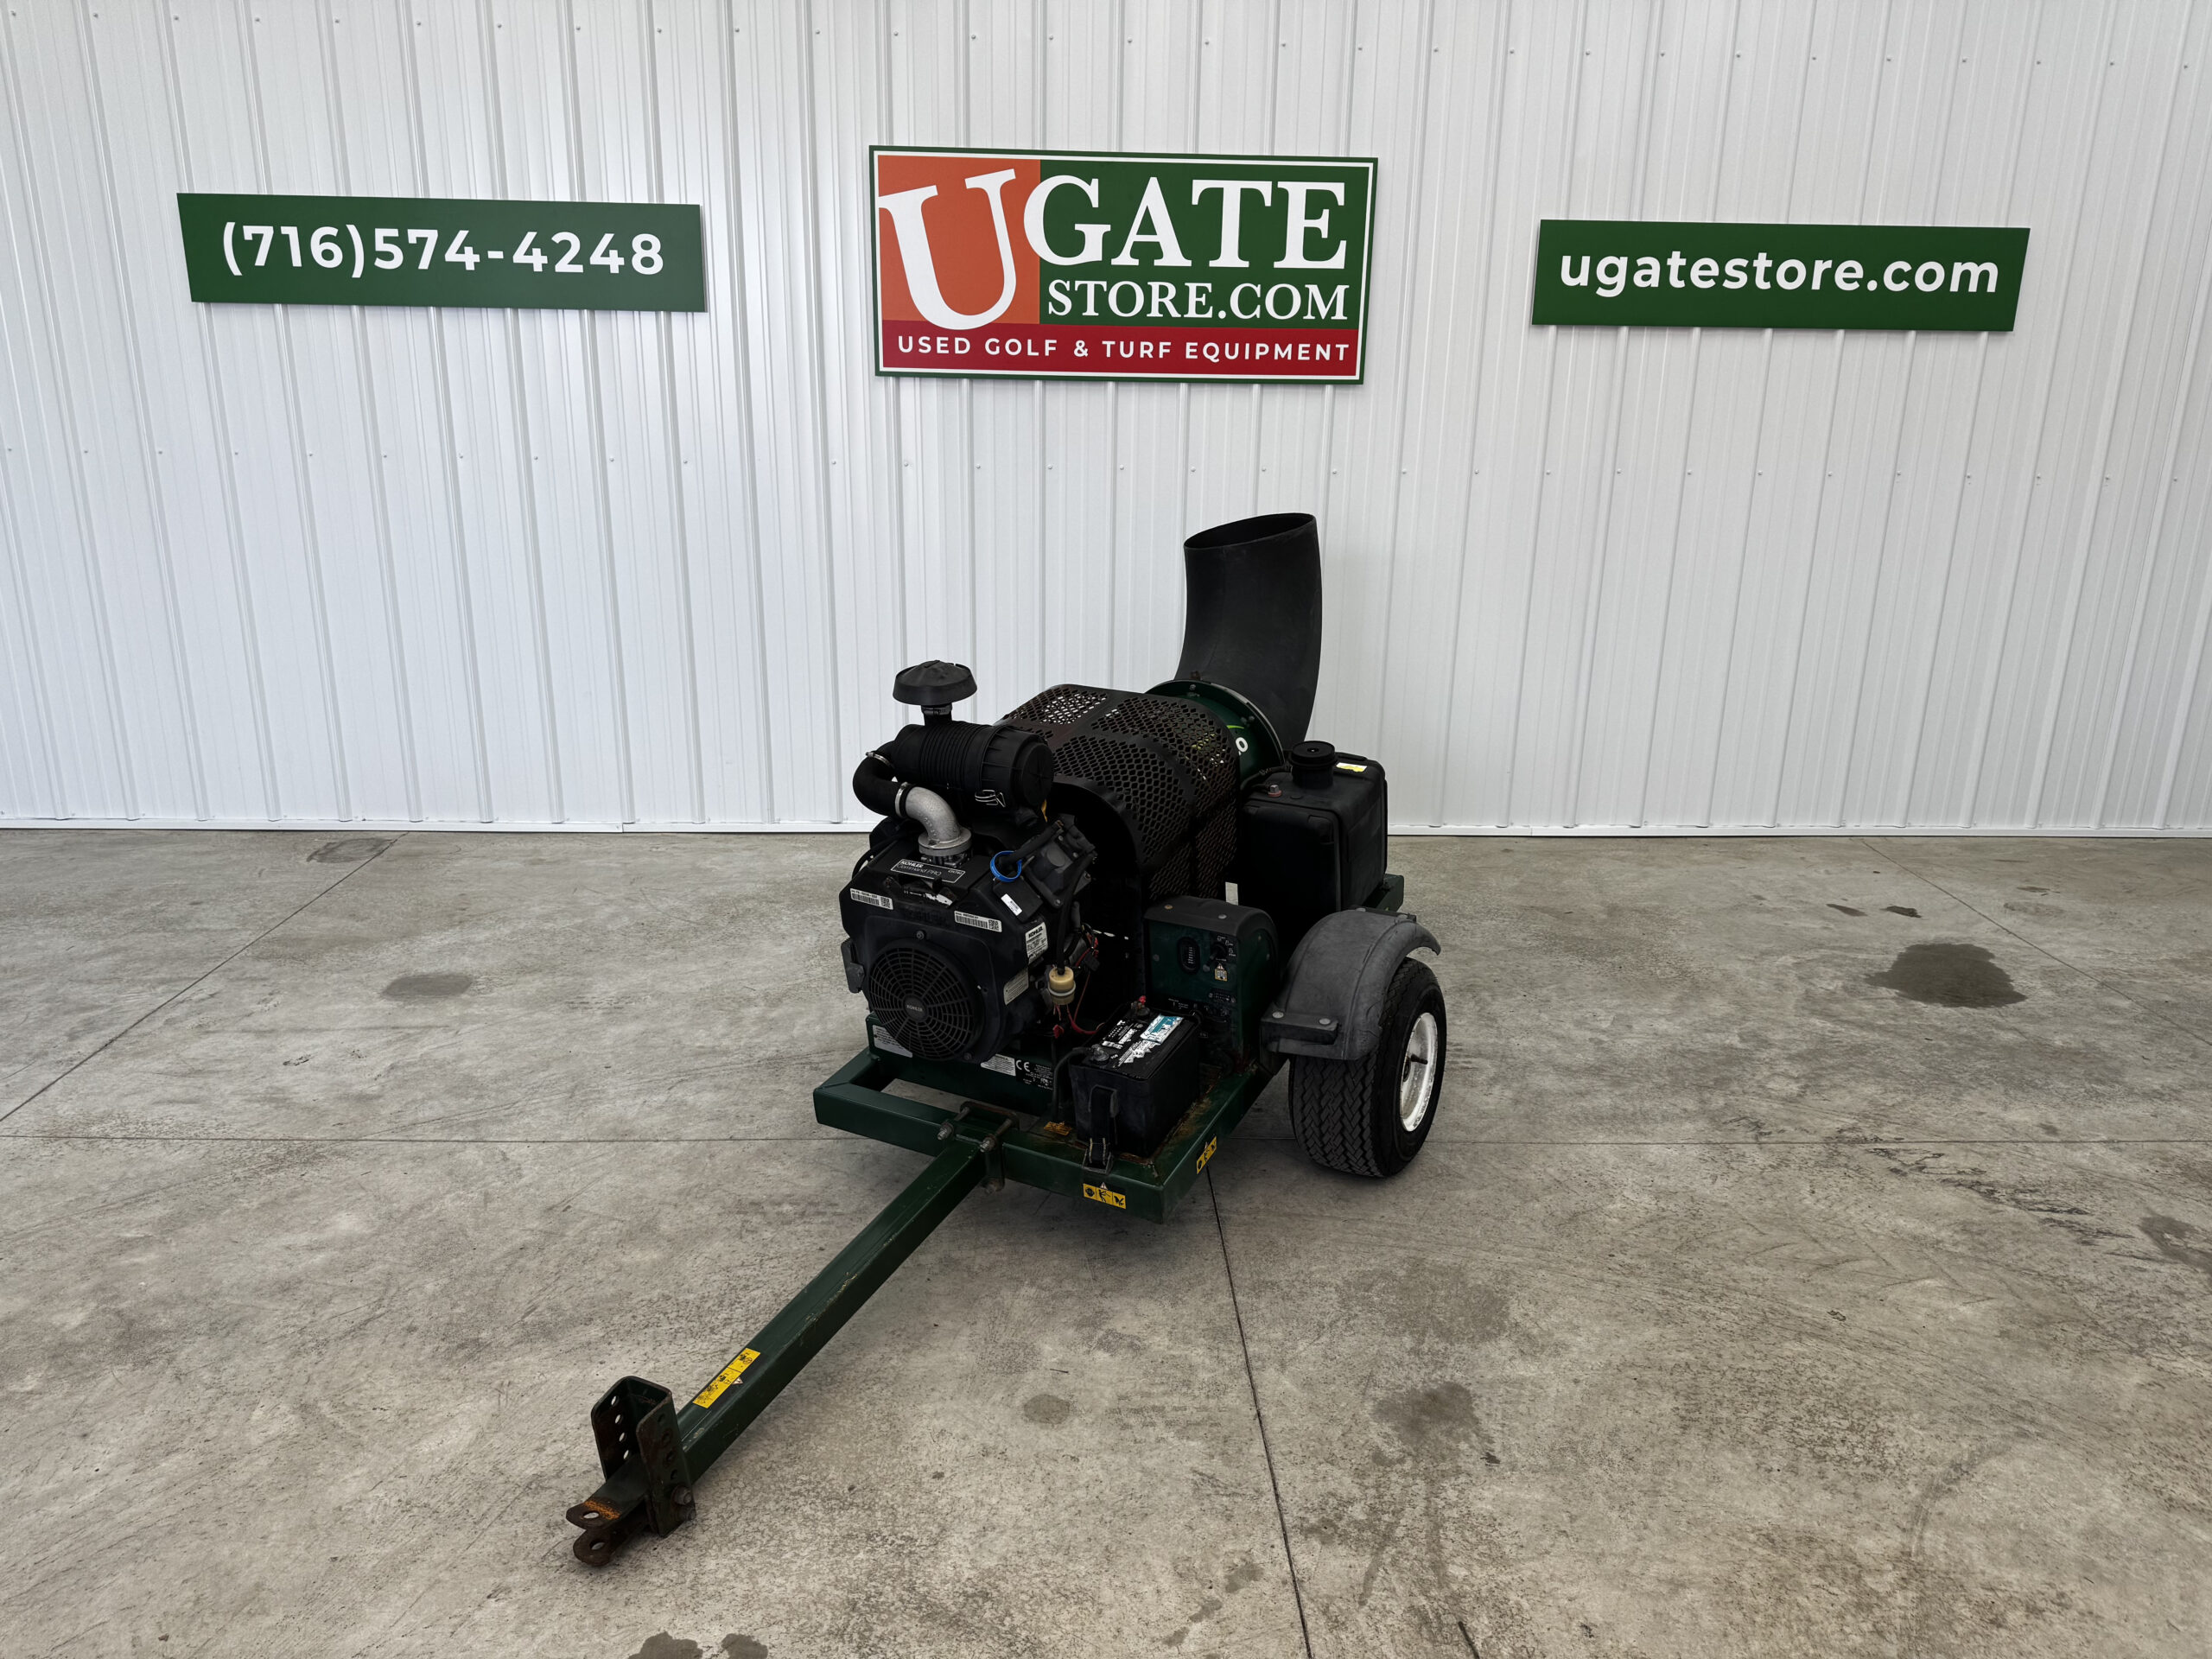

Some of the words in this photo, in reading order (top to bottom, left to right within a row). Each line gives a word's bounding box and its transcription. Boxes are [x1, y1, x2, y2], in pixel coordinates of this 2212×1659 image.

[223, 221, 664, 278] (716)574-4248
[1560, 251, 1999, 298] ugatestore.com
[1048, 279, 1350, 320] STORE.COM
[898, 335, 971, 354] USED
[984, 338, 1058, 357] GOLF
[1073, 340, 1089, 358] &
[1102, 340, 1172, 359] TURF
[1185, 341, 1350, 363] EQUIPMENT
[1027, 925, 1044, 938] KOHLER
[906, 1004, 924, 1013] KOHLER
